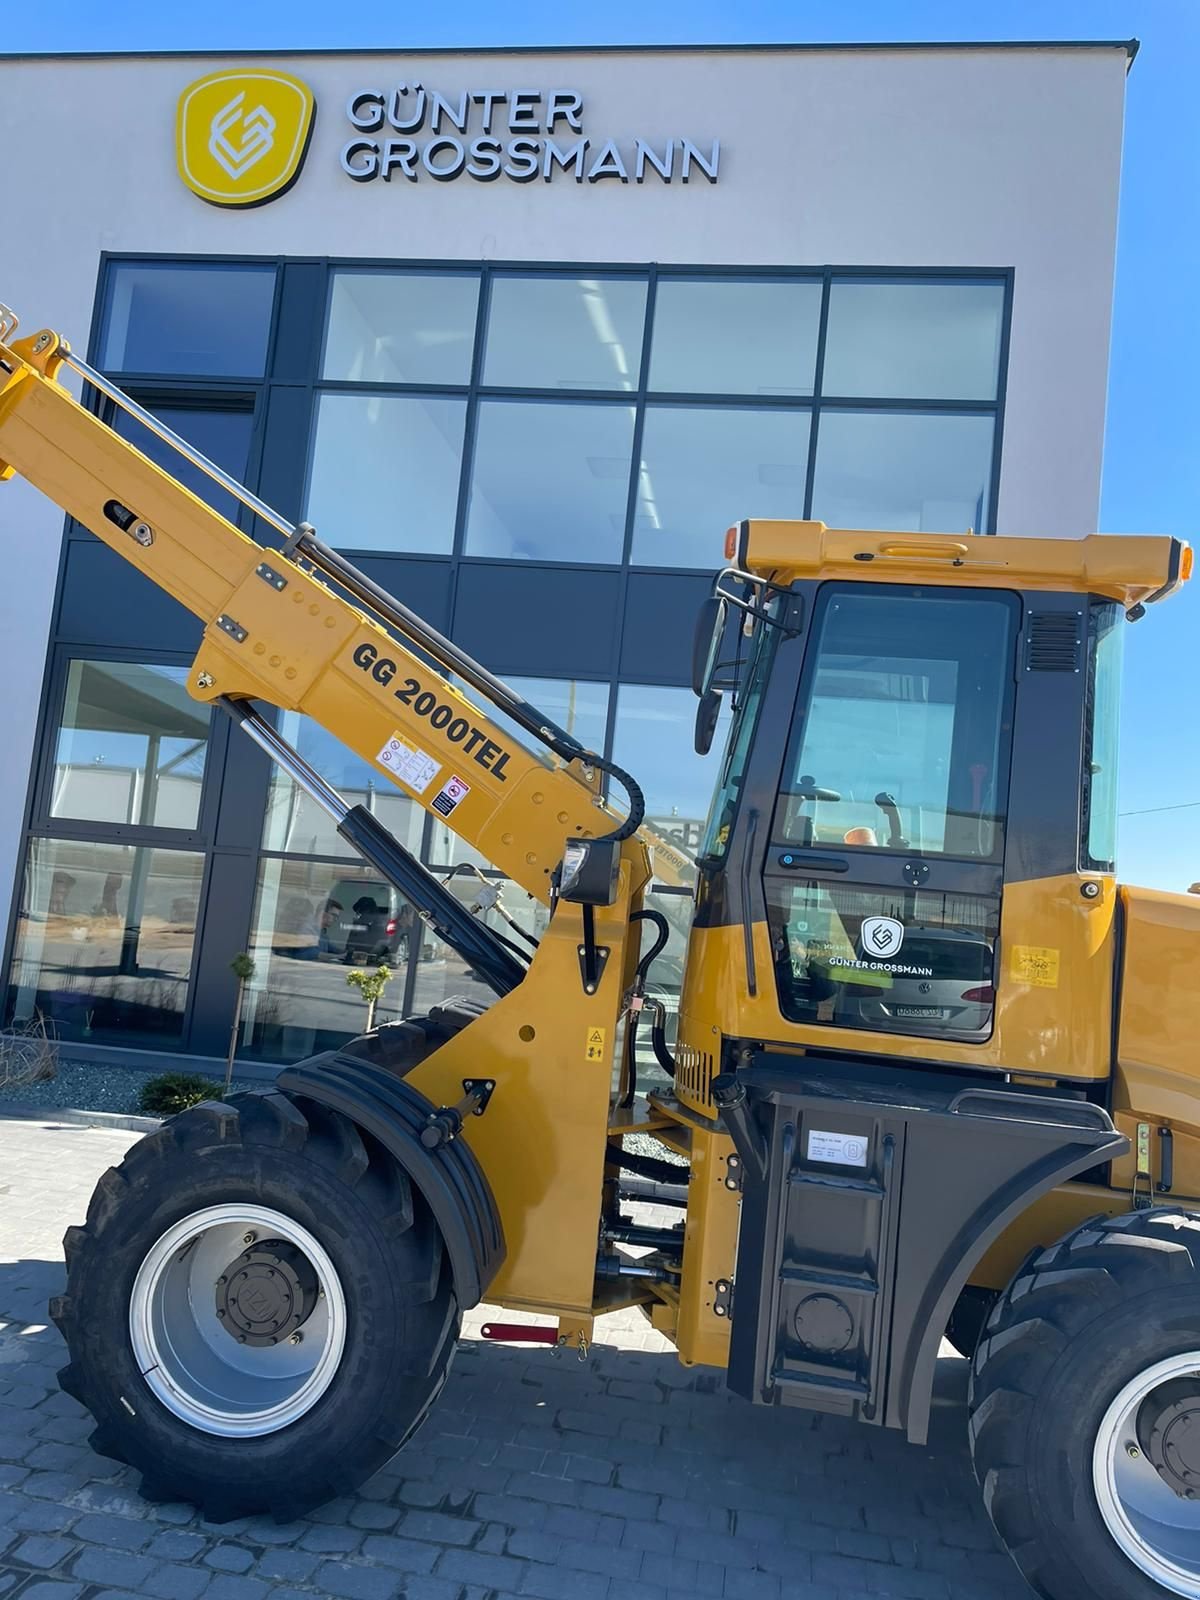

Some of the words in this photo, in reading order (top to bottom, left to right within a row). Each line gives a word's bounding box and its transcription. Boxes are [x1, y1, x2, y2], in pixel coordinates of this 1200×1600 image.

[347, 82, 583, 135] GÜNTER
[340, 135, 720, 184] GROSSMANN
[353, 643, 397, 687] GG
[394, 678, 511, 782] 2000TEL
[829, 955, 868, 969] GÜNTER
[869, 962, 933, 976] GROSSMANN
